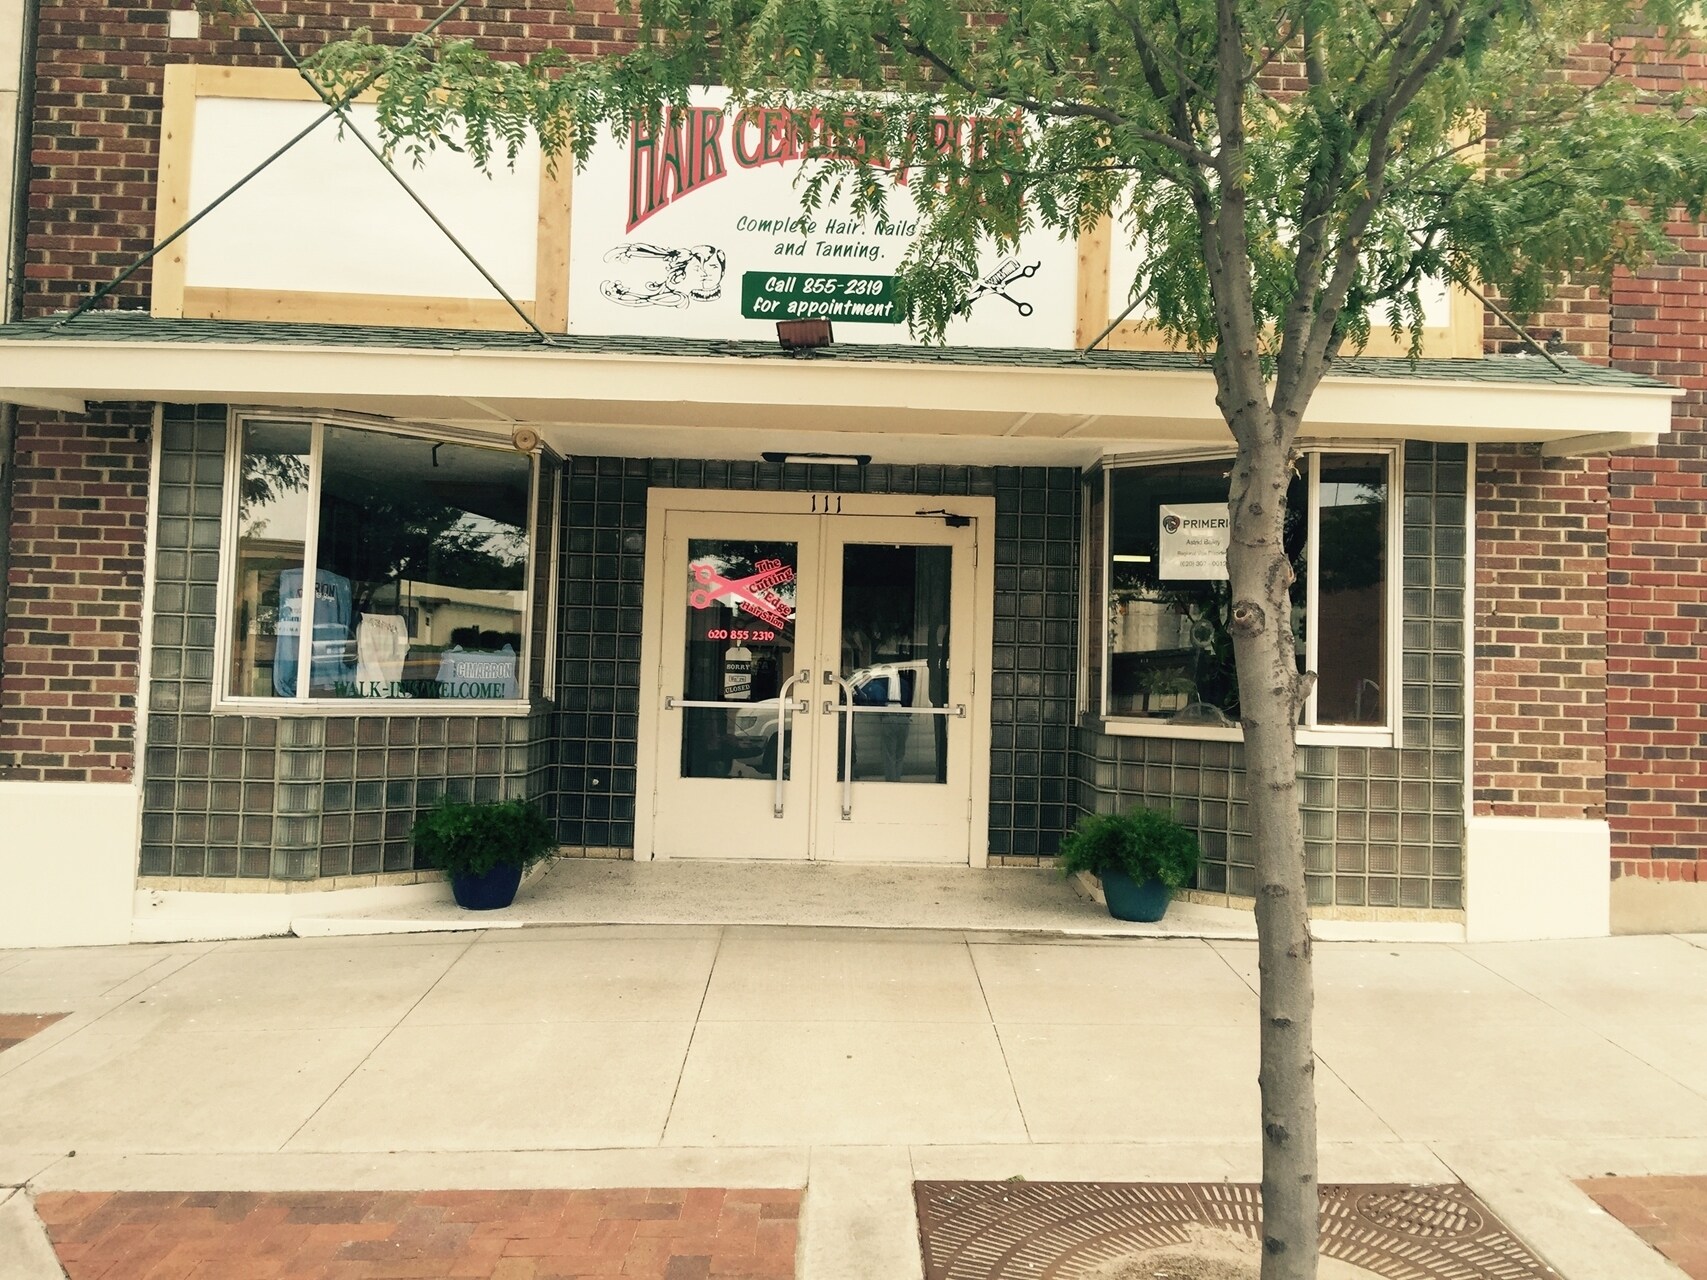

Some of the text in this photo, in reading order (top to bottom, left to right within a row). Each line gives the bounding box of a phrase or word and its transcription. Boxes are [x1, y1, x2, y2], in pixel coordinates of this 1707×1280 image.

[626, 105, 890, 235] HAIR CENTE
[774, 240, 885, 261] and Tanning.
[765, 276, 883, 295] Call 855-2319
[753, 296, 893, 316] for appointment
[811, 494, 841, 513] 111
[755, 558, 782, 573] The
[748, 567, 794, 594] Cutting
[764, 591, 791, 616] Edge
[741, 600, 784, 630] Hair Salon
[708, 629, 774, 641] 620 855 2319
[457, 661, 512, 679] CIMARRON
[425, 681, 505, 699] WELCOME!
[725, 684, 750, 694] CLOSED
